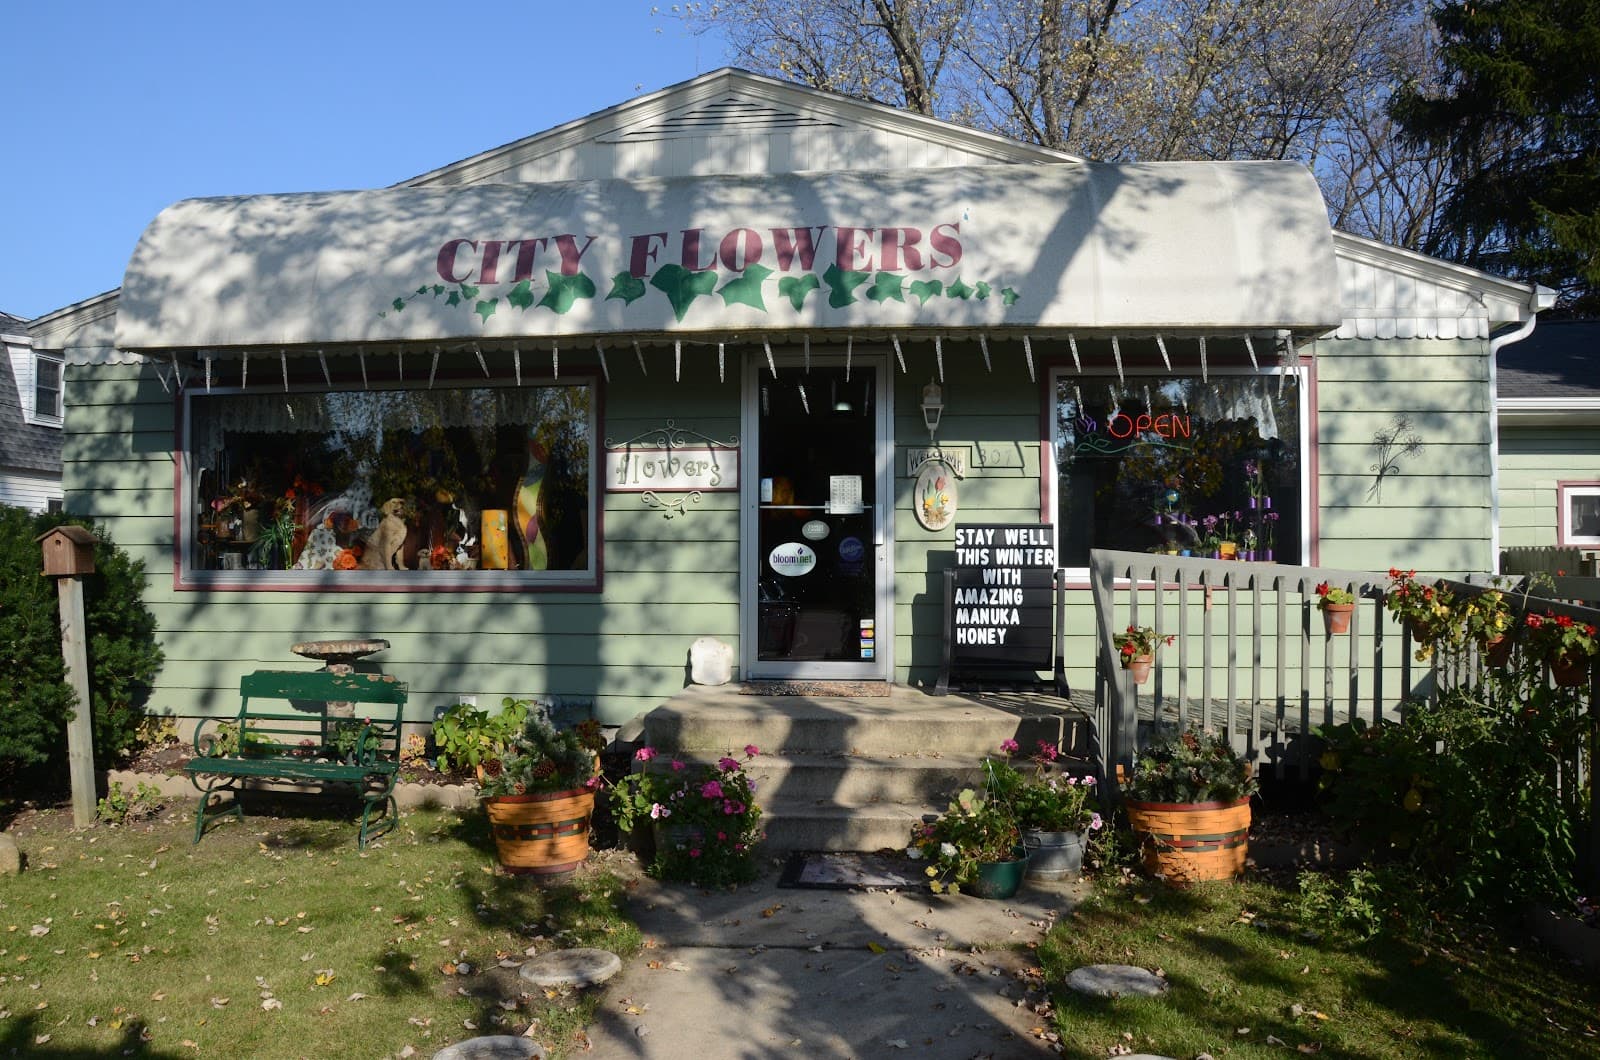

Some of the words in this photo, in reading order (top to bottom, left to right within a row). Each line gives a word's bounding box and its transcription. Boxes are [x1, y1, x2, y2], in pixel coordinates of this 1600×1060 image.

[436, 234, 598, 285] CITY
[629, 222, 963, 279] FLOWERS
[1108, 413, 1191, 439] OPEN
[615, 454, 722, 487] flowers
[955, 528, 995, 546] STAY
[1004, 528, 1049, 546] WELL
[955, 548, 990, 565] THIS
[995, 548, 1054, 565] WINTER
[982, 568, 1022, 585] WITH
[954, 588, 1024, 605] AMAZING
[955, 608, 1020, 625] MANUKA
[956, 628, 1007, 645] HONEY
